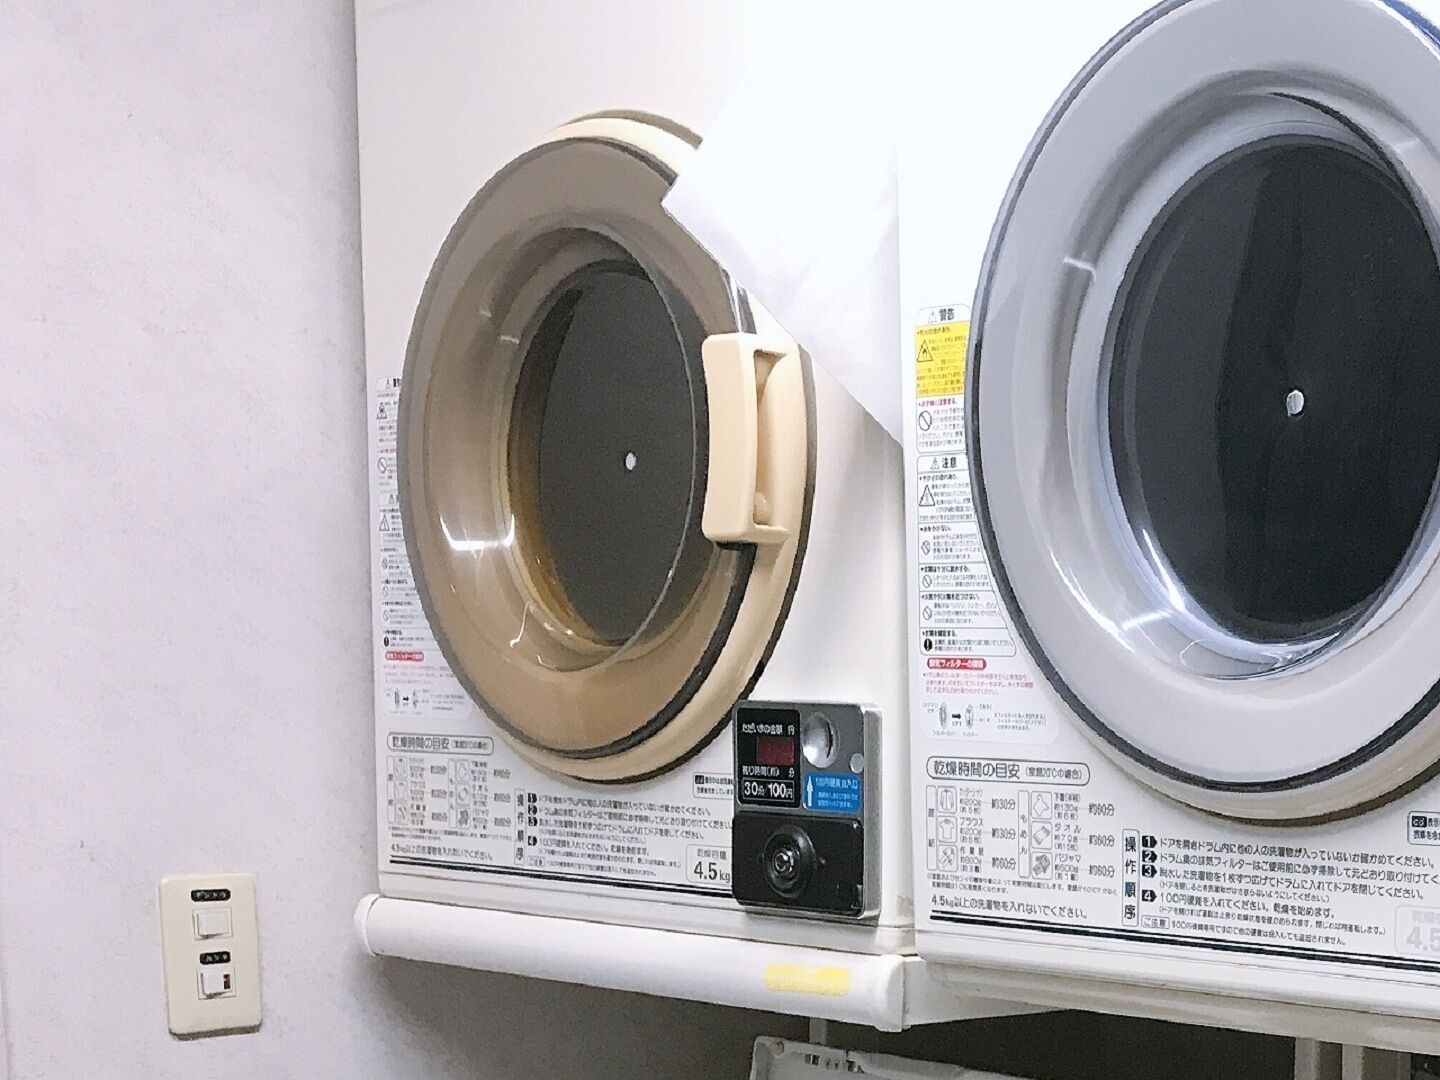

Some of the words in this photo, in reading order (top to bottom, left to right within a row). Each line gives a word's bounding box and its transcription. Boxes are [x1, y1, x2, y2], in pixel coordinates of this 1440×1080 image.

[941, 456, 957, 469] 注意
[787, 725, 795, 736] 円
[788, 768, 795, 778] 分
[933, 760, 1020, 780] 乾燥時間の目安
[1054, 854, 1082, 863] パジャマ
[1124, 836, 1136, 920] 操作順序
